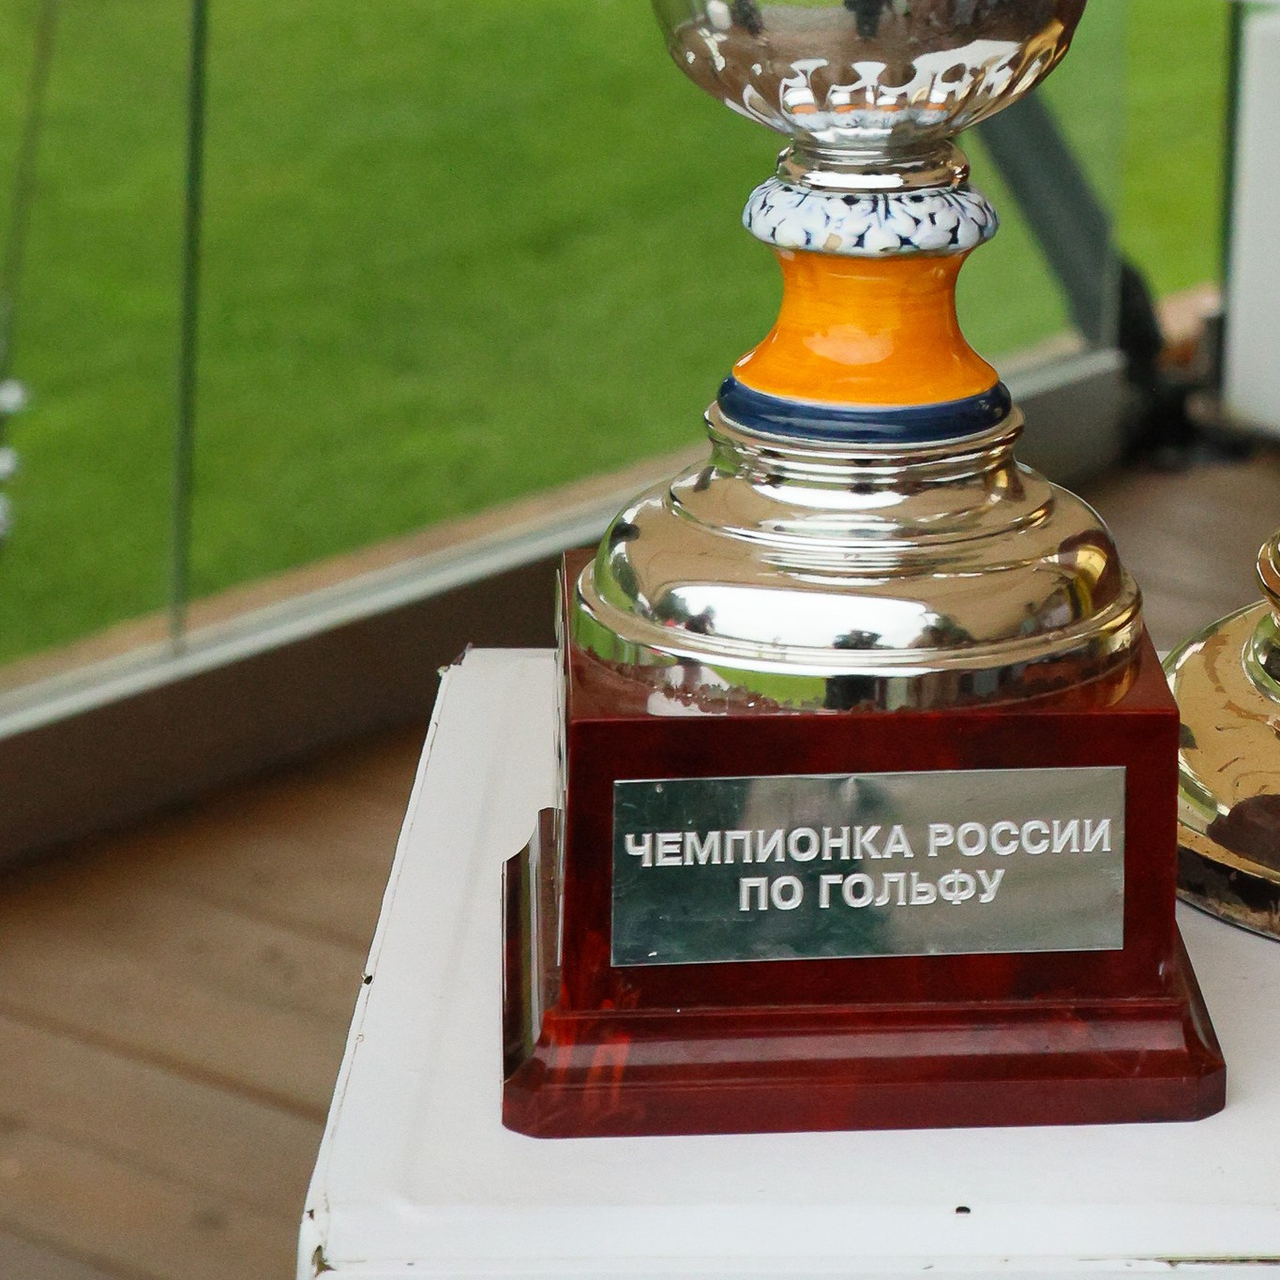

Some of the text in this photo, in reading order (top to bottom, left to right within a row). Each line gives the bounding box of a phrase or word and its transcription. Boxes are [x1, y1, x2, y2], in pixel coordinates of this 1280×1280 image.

[625, 818, 1113, 868] ЧЕМПИОНКА РОССИИ
[739, 868, 1005, 912] ПО ГОЛЬФУ
